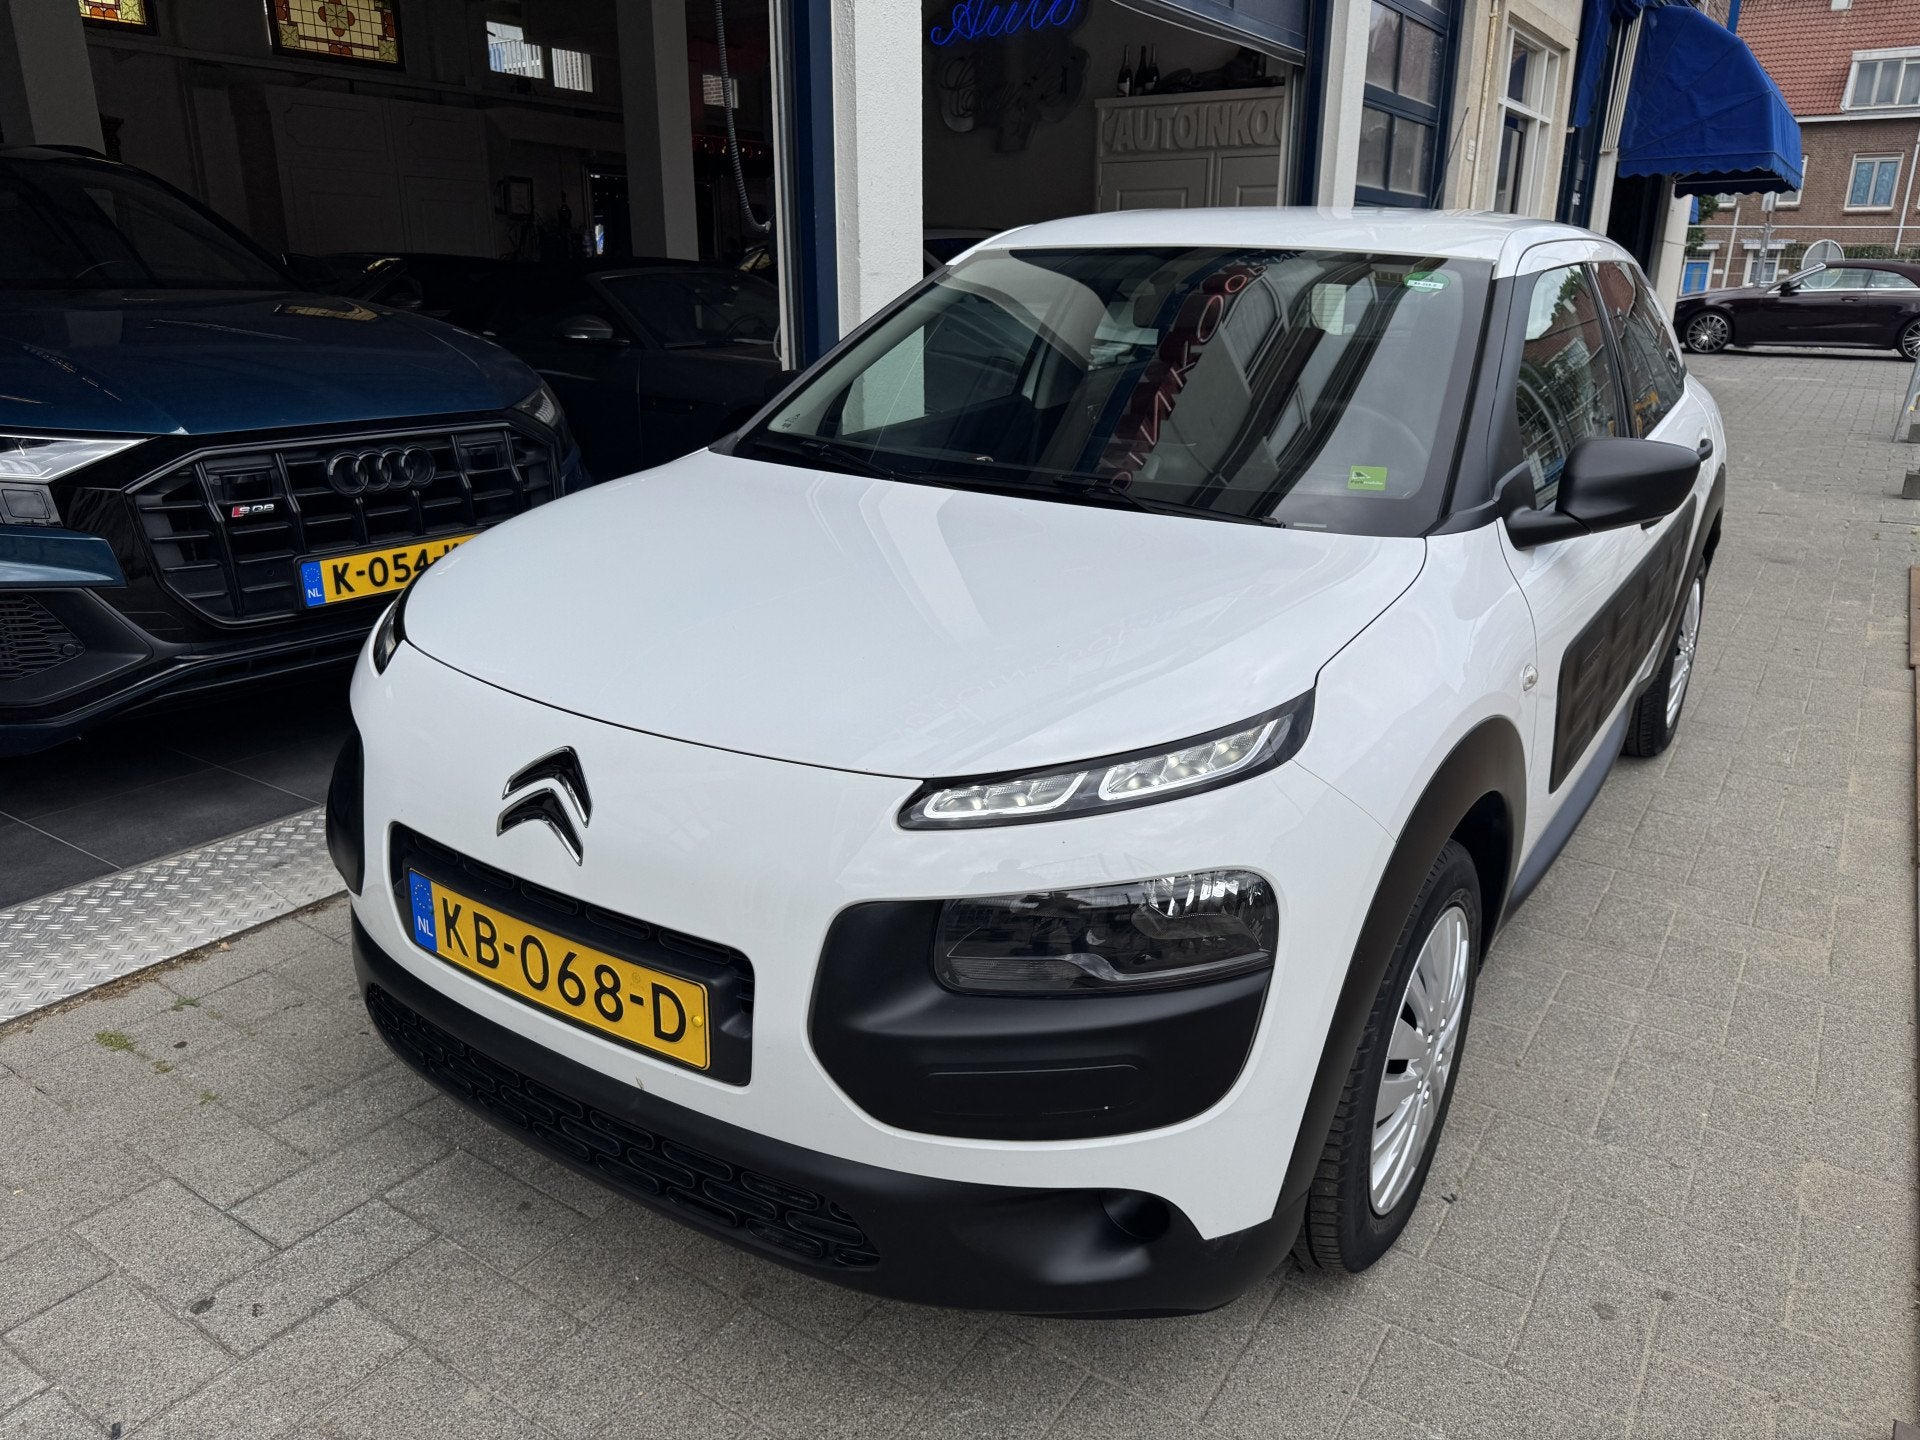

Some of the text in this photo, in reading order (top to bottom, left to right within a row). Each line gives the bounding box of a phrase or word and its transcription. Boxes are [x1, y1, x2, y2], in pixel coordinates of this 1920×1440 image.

[1111, 100, 1282, 151] AUTOINKO
[307, 588, 322, 598] NL
[332, 543, 459, 595] K-054-
[417, 915, 433, 937] NL
[442, 897, 686, 1043] KB-068-D
